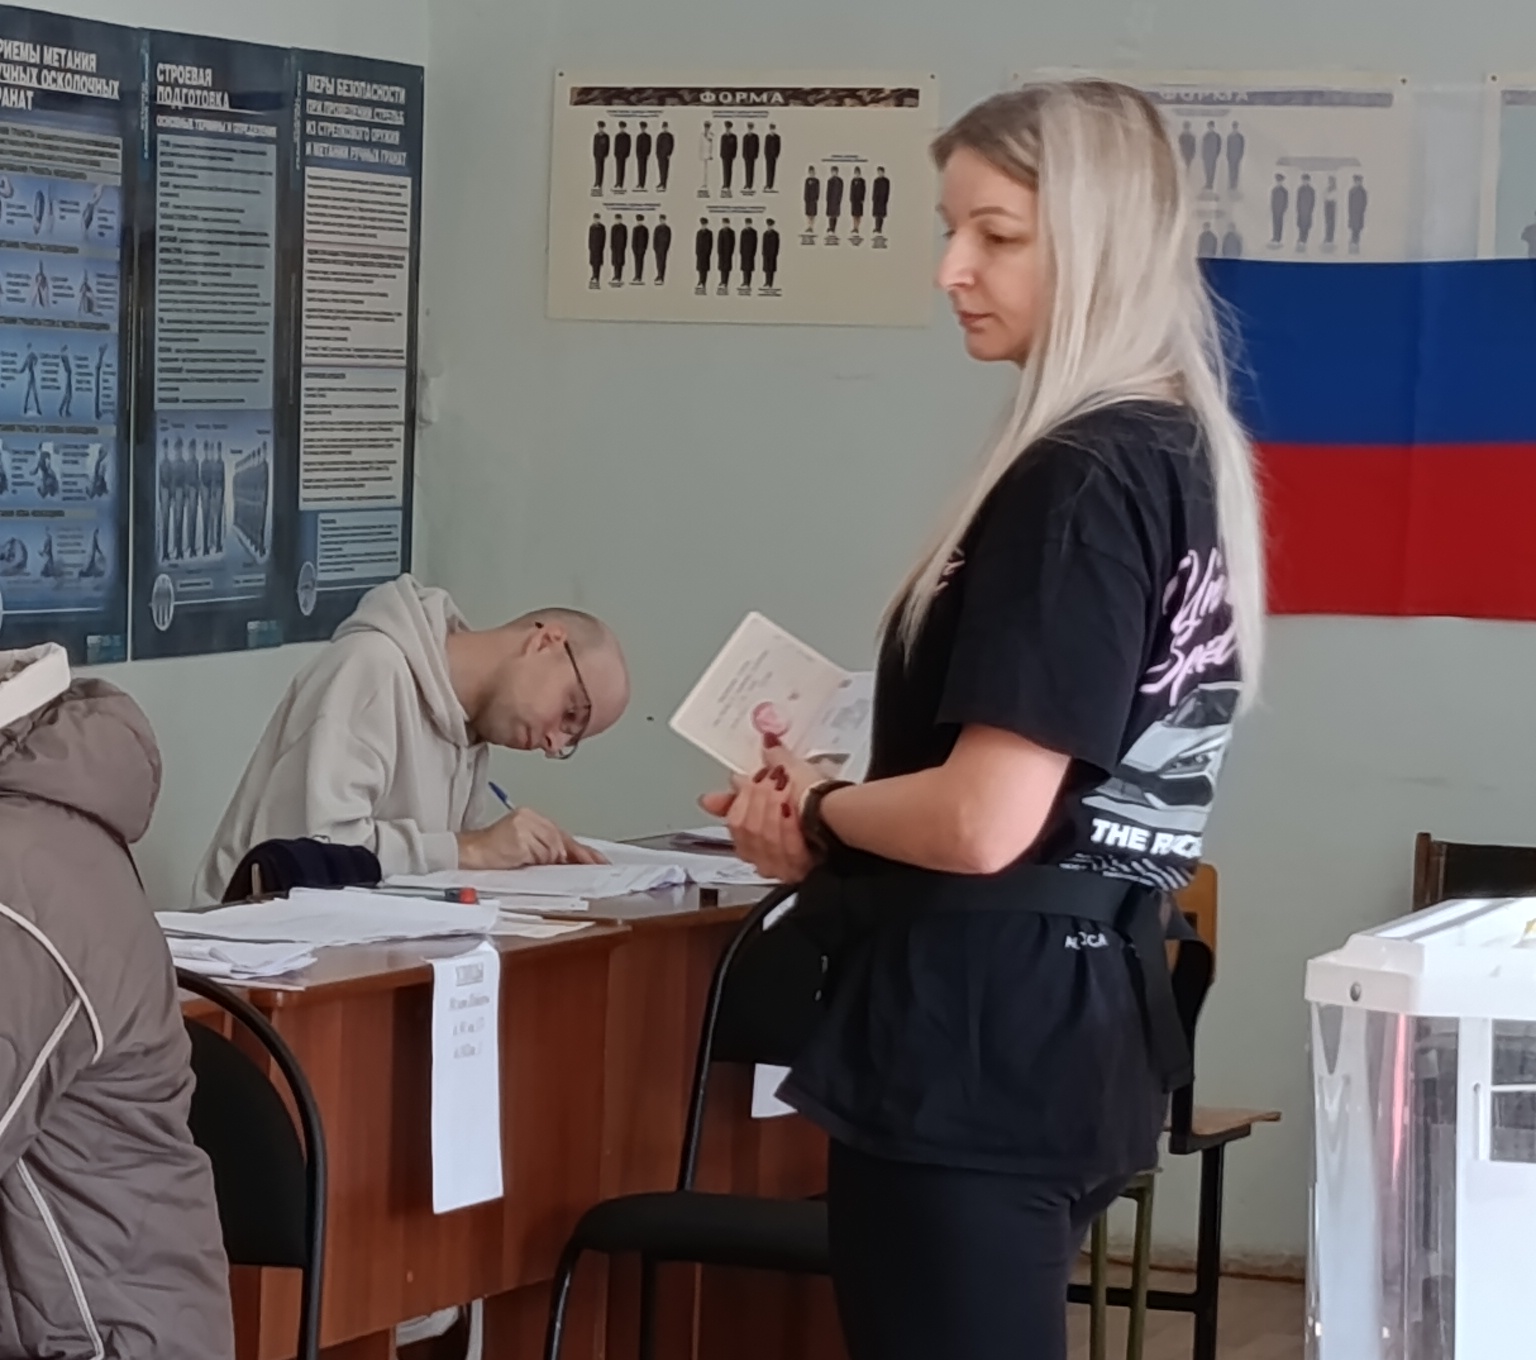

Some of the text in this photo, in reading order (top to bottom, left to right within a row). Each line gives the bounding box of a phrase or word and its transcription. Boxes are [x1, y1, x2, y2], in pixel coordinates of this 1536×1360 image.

[43, 45, 96, 73] МЕТАНИЯ
[41, 69, 120, 100] ОСКОЛОЧНЫХ
[157, 62, 212, 87] СТРОЕВАЯ
[156, 85, 230, 110] ПОДГОТОВКА
[306, 74, 405, 104] МЕРЫ БЕЗОПАСНОСТИ
[699, 91, 784, 104] ФОРМА
[1090, 818, 1151, 852] THE
